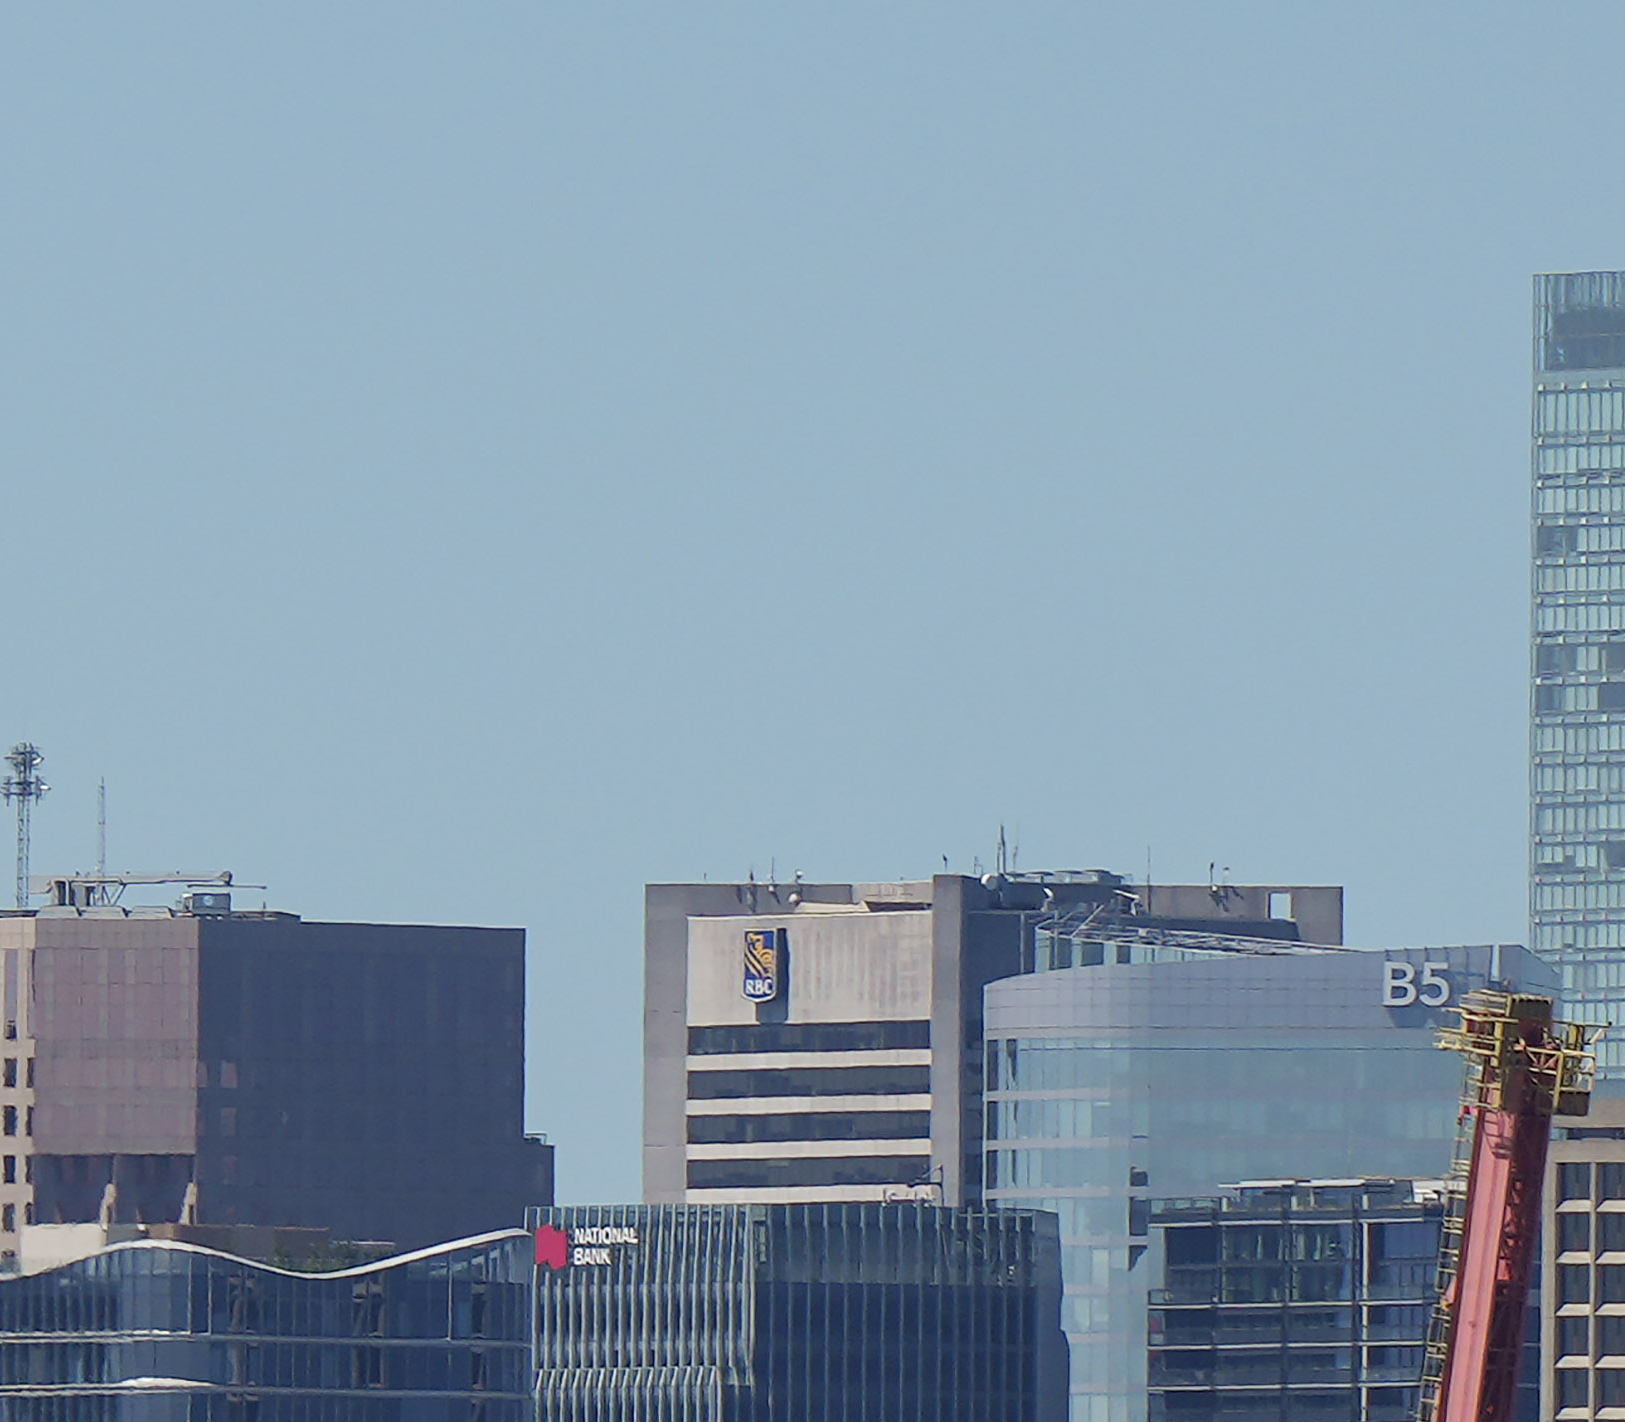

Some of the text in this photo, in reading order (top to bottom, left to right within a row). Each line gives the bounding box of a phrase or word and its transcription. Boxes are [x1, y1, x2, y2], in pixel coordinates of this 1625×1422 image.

[745, 979, 774, 995] RBC
[1383, 961, 1450, 1006] B5
[574, 1227, 638, 1244] NATIONAL
[574, 1248, 611, 1265] BANK
